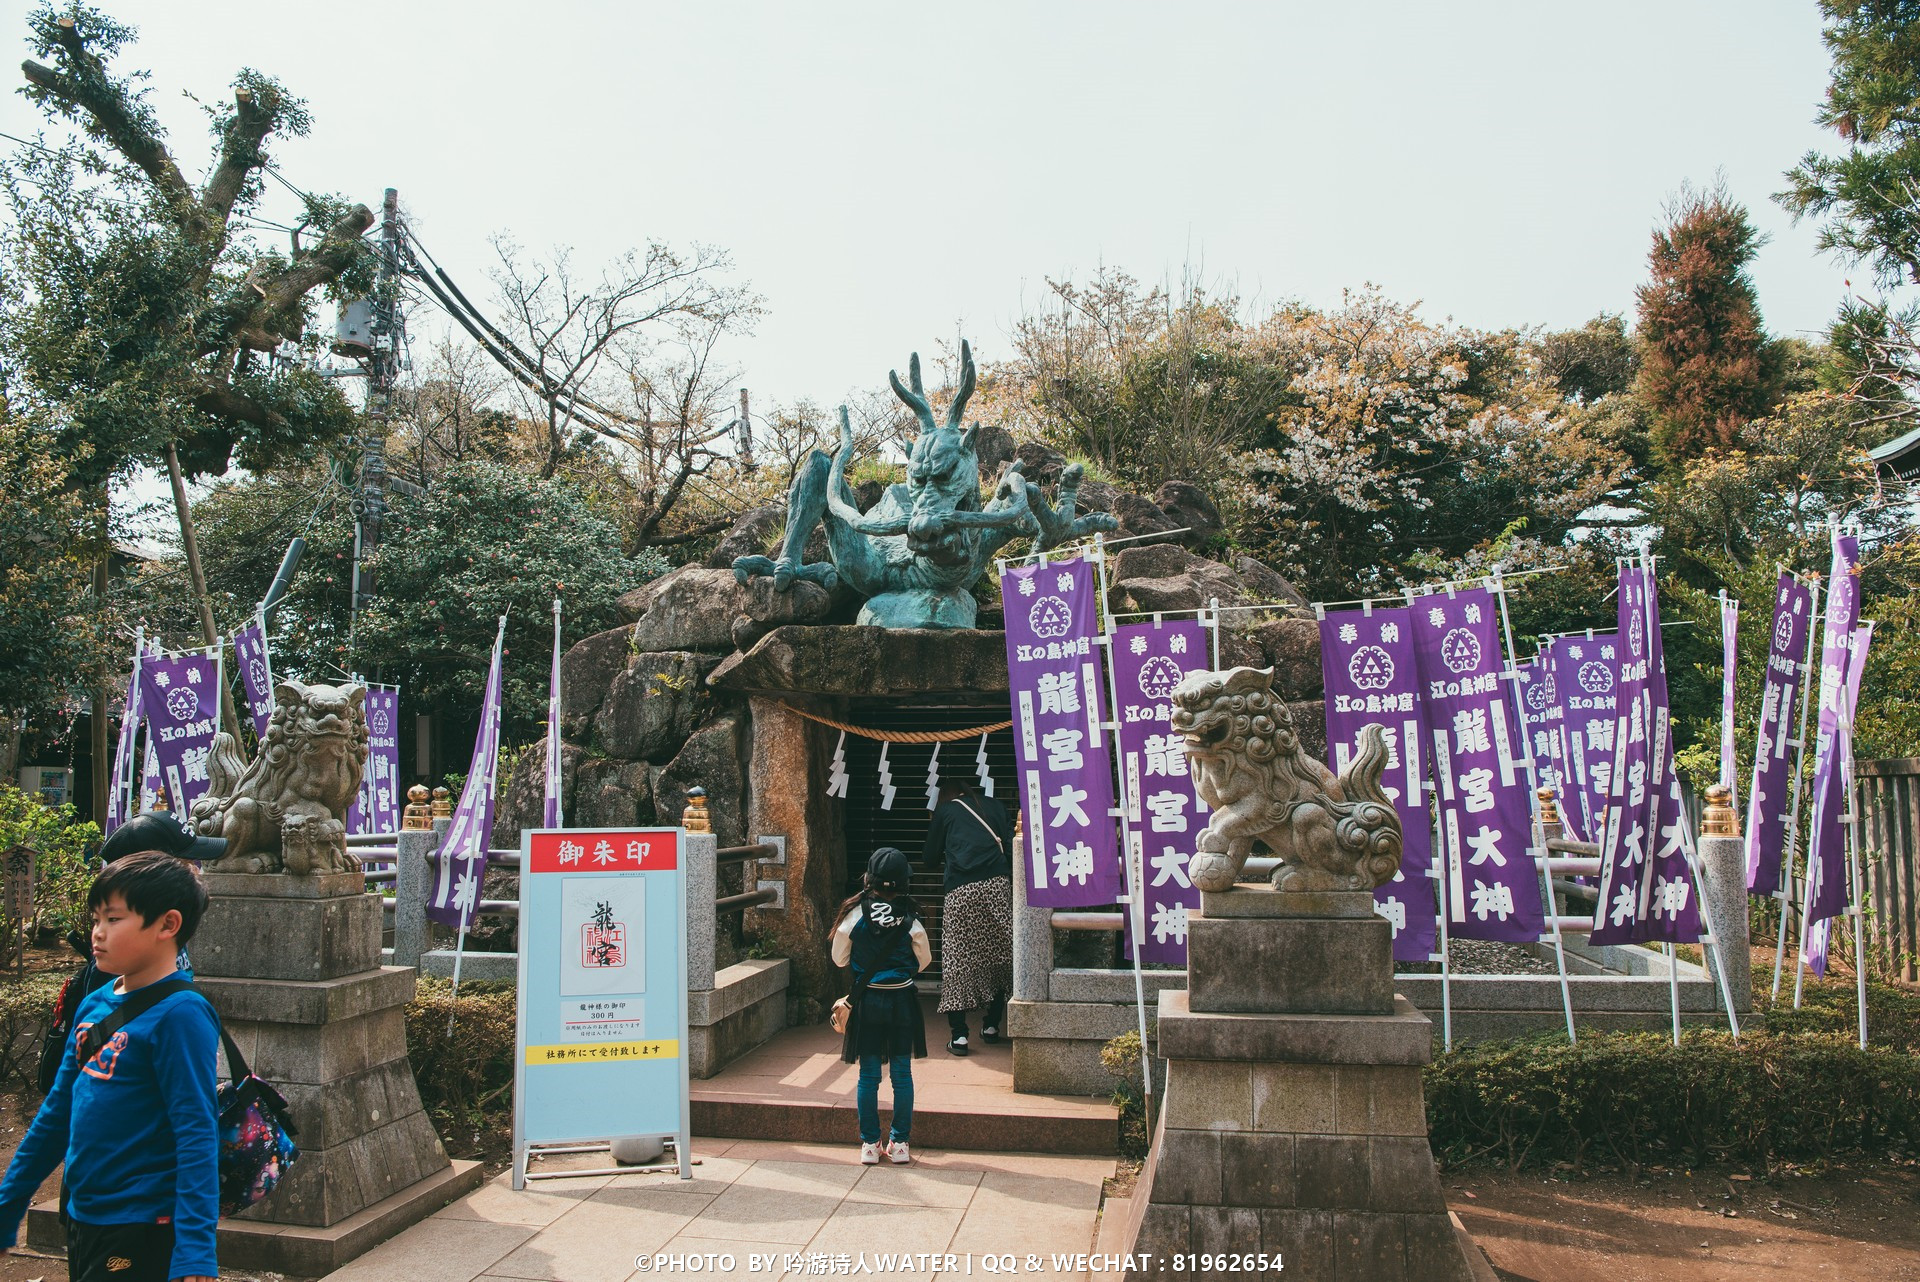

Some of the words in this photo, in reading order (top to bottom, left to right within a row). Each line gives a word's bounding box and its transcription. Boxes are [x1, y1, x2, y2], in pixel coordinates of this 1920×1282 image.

[1569, 695, 1616, 710] 江の島神
[1125, 703, 1175, 723] 江の島
[1037, 671, 1094, 886] 龍宮大神
[1453, 708, 1515, 922] 龍宮大神
[557, 839, 652, 867] 御朱印
[580, 1002, 626, 1011] 龍神様の御印
[591, 1012, 605, 1020] 300
[546, 1045, 661, 1059] 社務所にて受付致します
